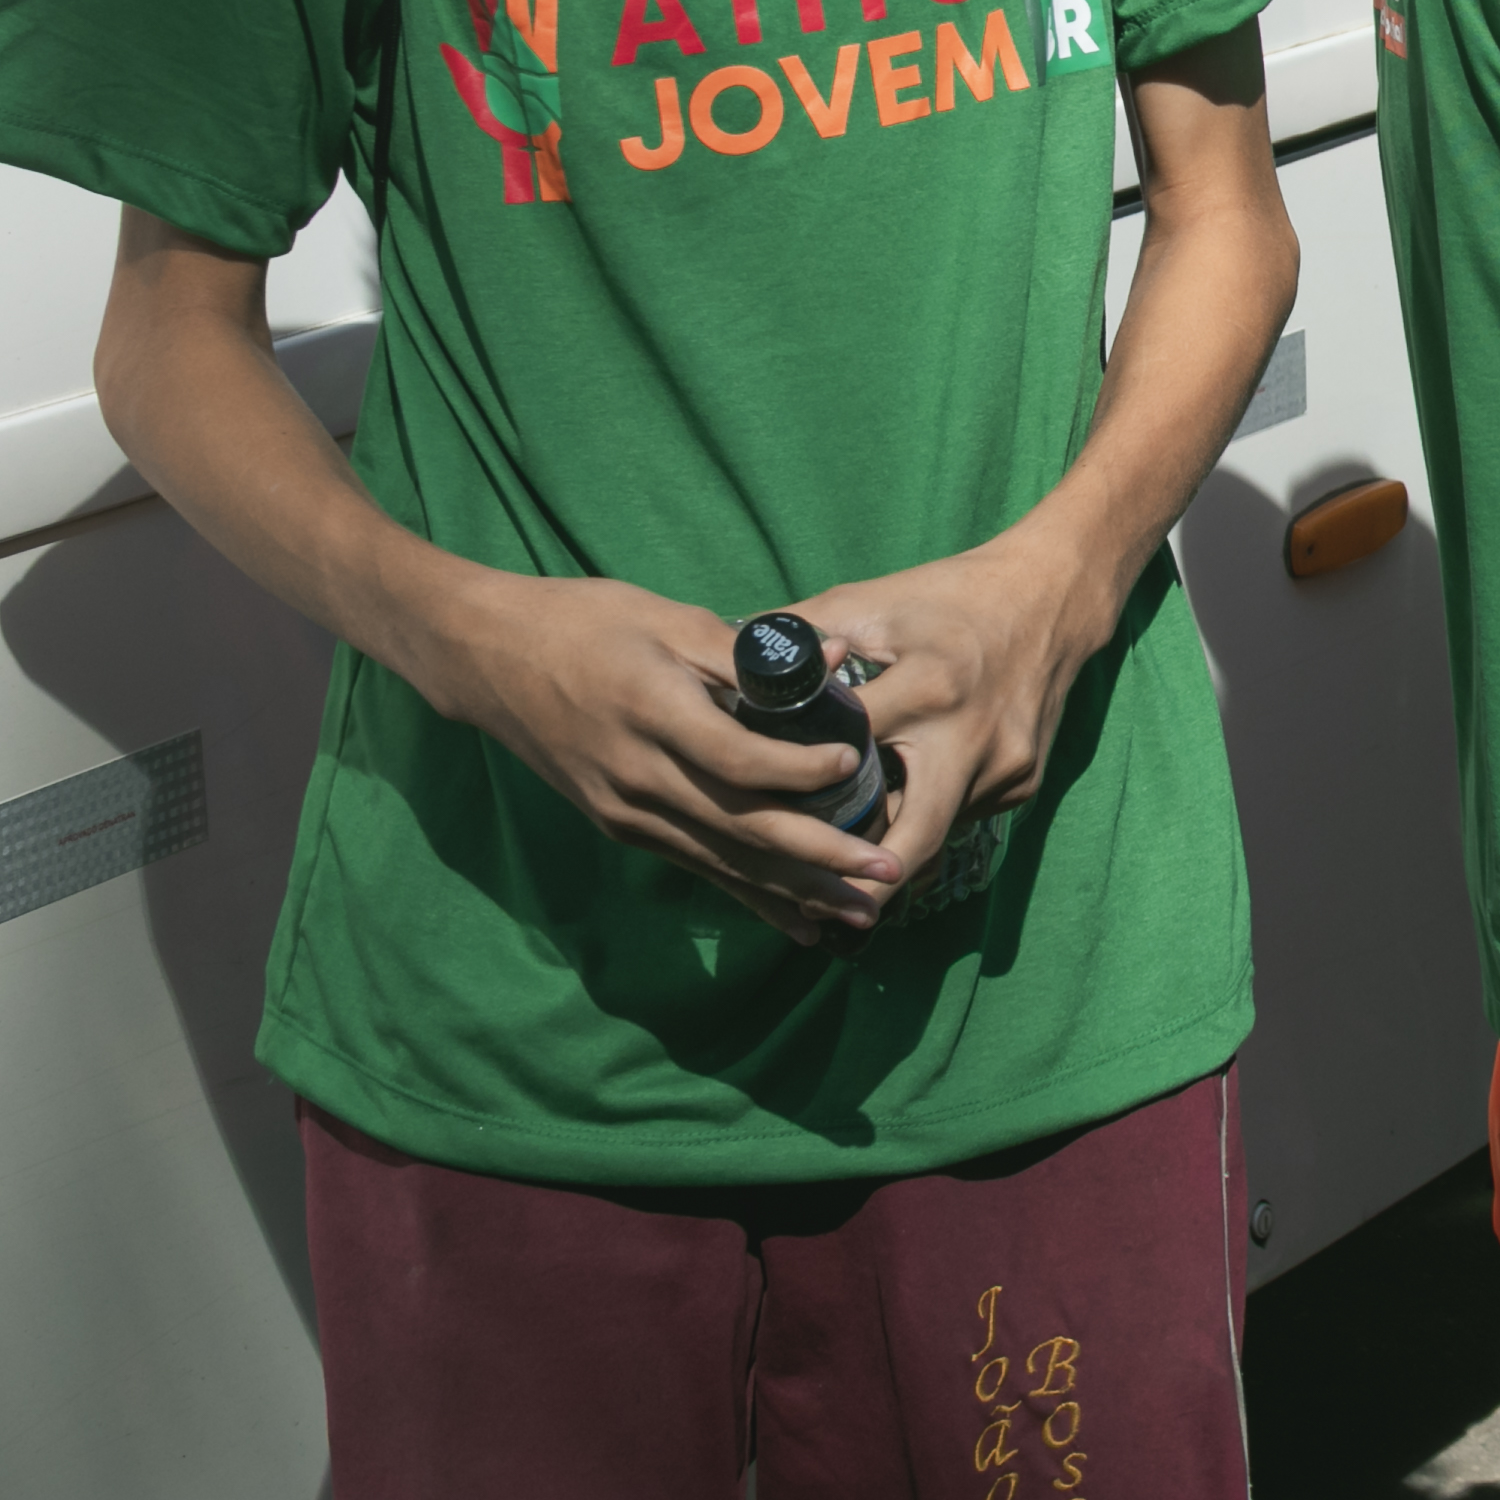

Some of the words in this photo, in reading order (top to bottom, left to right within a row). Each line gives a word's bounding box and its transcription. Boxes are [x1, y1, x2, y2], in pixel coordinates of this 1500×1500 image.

[619, 9, 1030, 171] JOVEM
[753, 623, 800, 663] Valle
[1026, 1335, 1082, 1500] Bos
